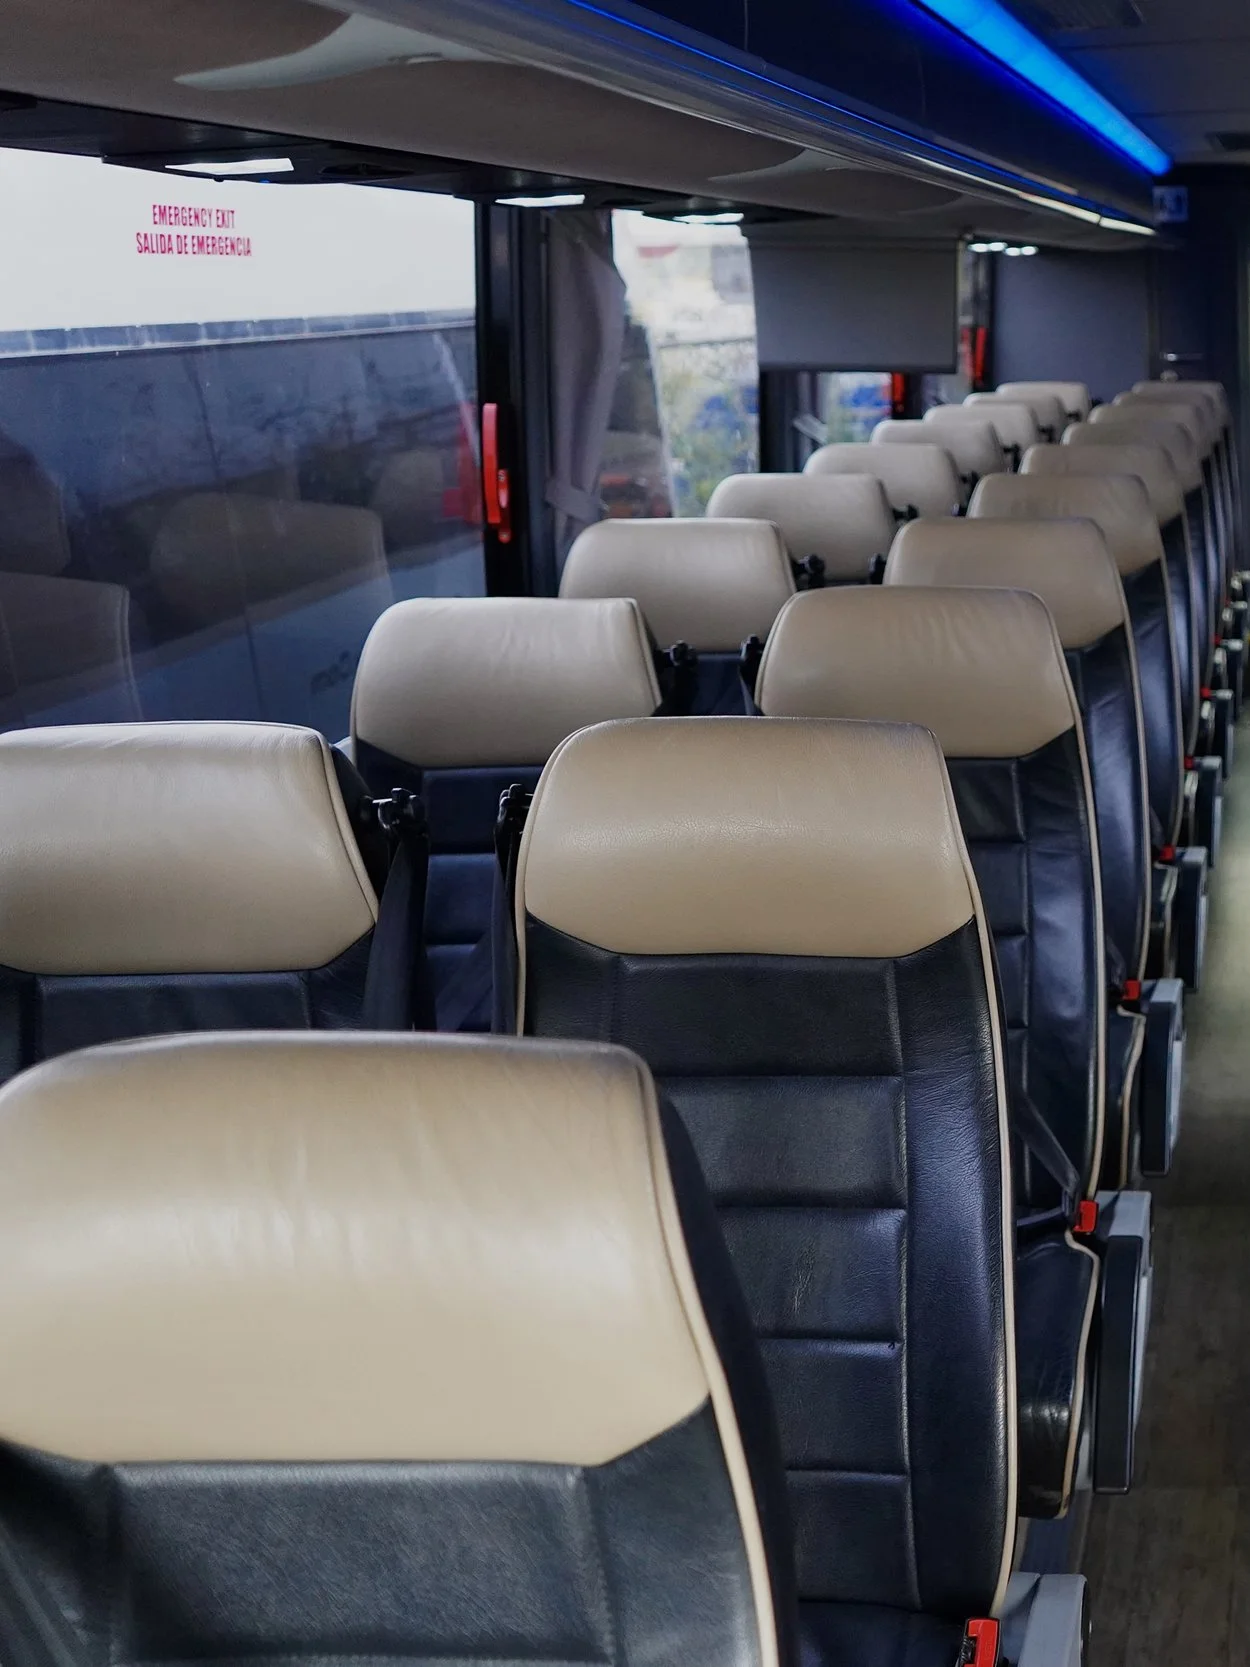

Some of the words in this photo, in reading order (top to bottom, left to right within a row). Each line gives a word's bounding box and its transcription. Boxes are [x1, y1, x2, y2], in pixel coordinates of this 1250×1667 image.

[153, 205, 213, 228] EMERGENCY
[216, 209, 235, 228] EXIT
[136, 232, 173, 254] SALIDA
[176, 235, 188, 254] DE
[191, 235, 251, 256] EMERGENCIA
